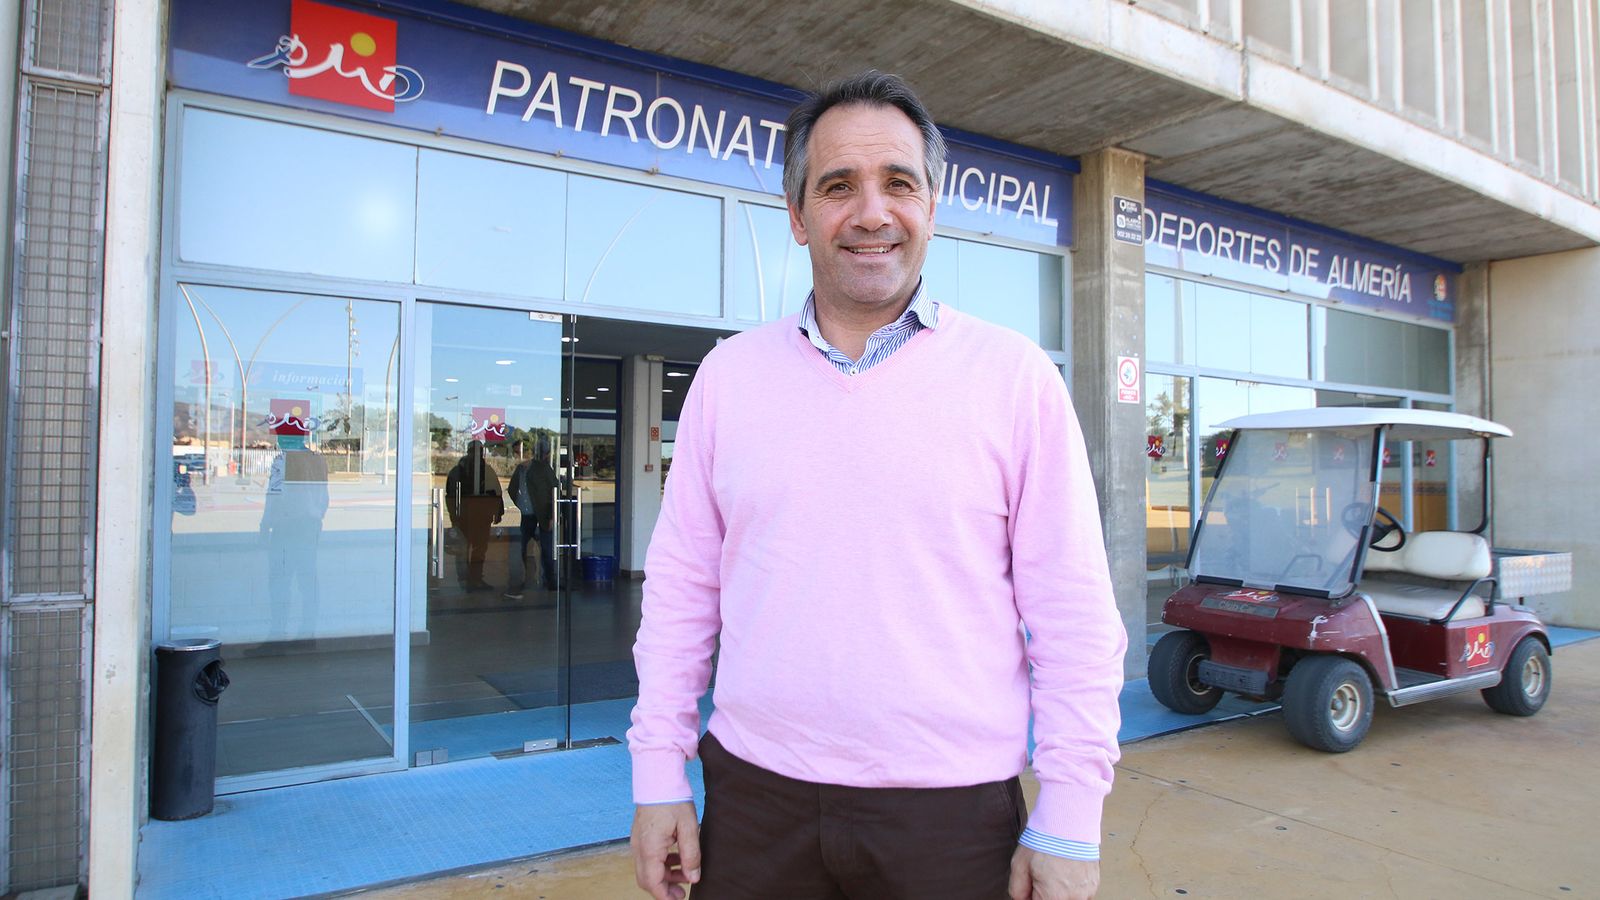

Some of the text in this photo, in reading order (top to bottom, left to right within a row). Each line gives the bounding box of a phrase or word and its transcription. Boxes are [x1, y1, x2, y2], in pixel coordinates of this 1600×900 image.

[486, 60, 1412, 304] PATRONAT ICIPAL DEPORTES DE ALMERÍA
